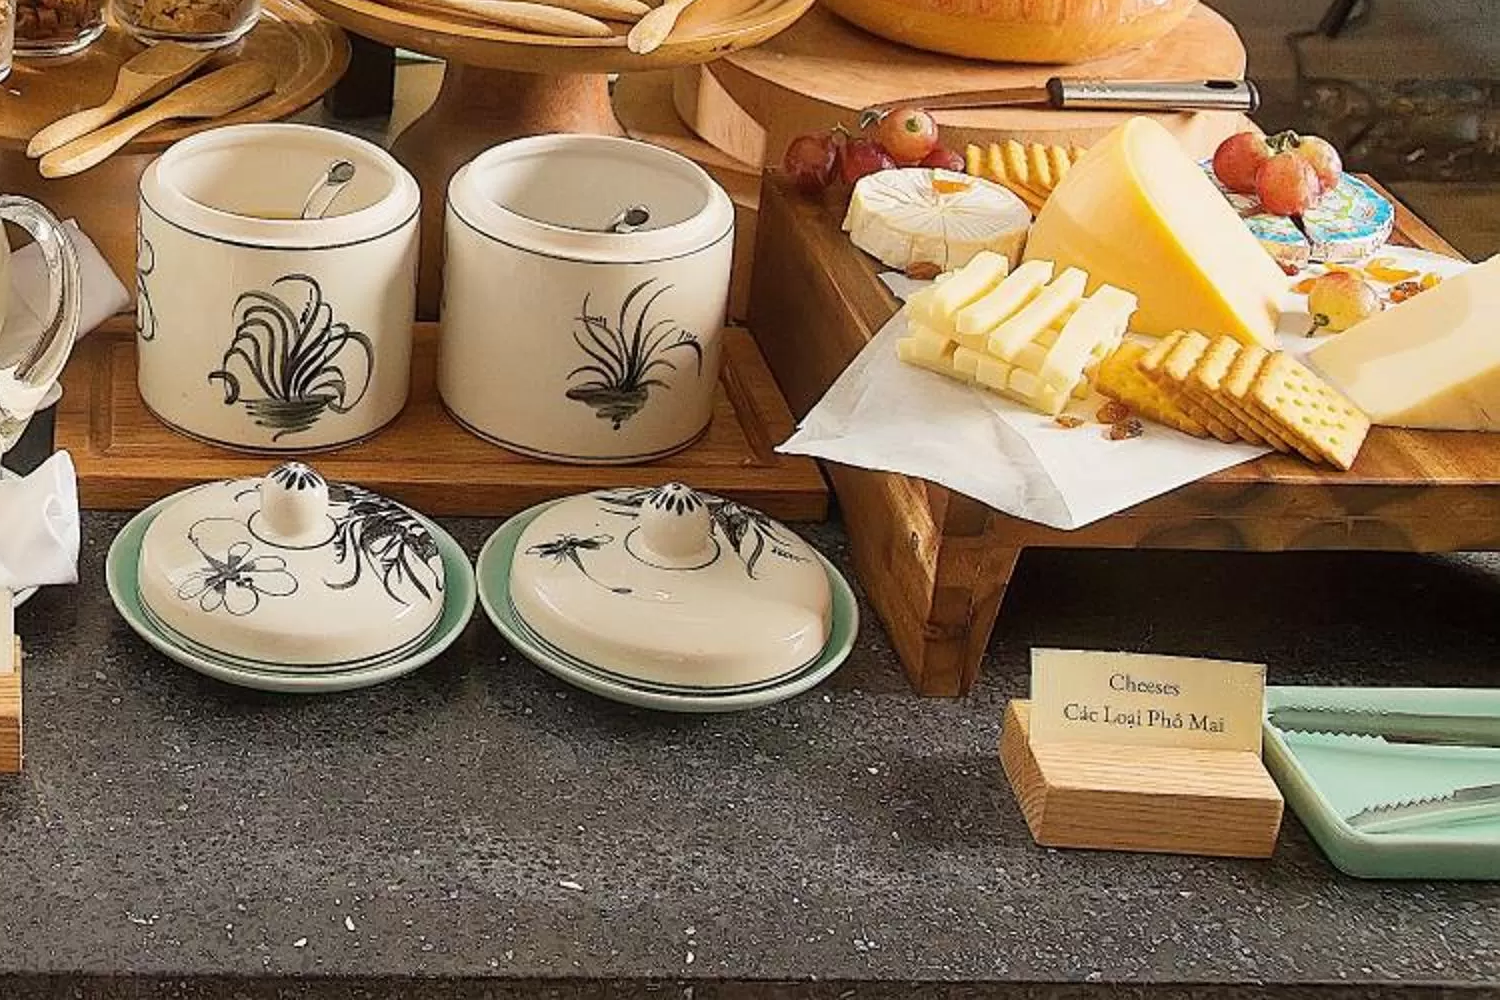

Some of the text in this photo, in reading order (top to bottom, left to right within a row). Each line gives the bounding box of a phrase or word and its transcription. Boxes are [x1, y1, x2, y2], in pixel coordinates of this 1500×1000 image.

[1109, 673, 1181, 697] Cheeses
[1063, 703, 1099, 723] Các
[1104, 705, 1142, 729] Loại
[1188, 713, 1225, 733] Mai
